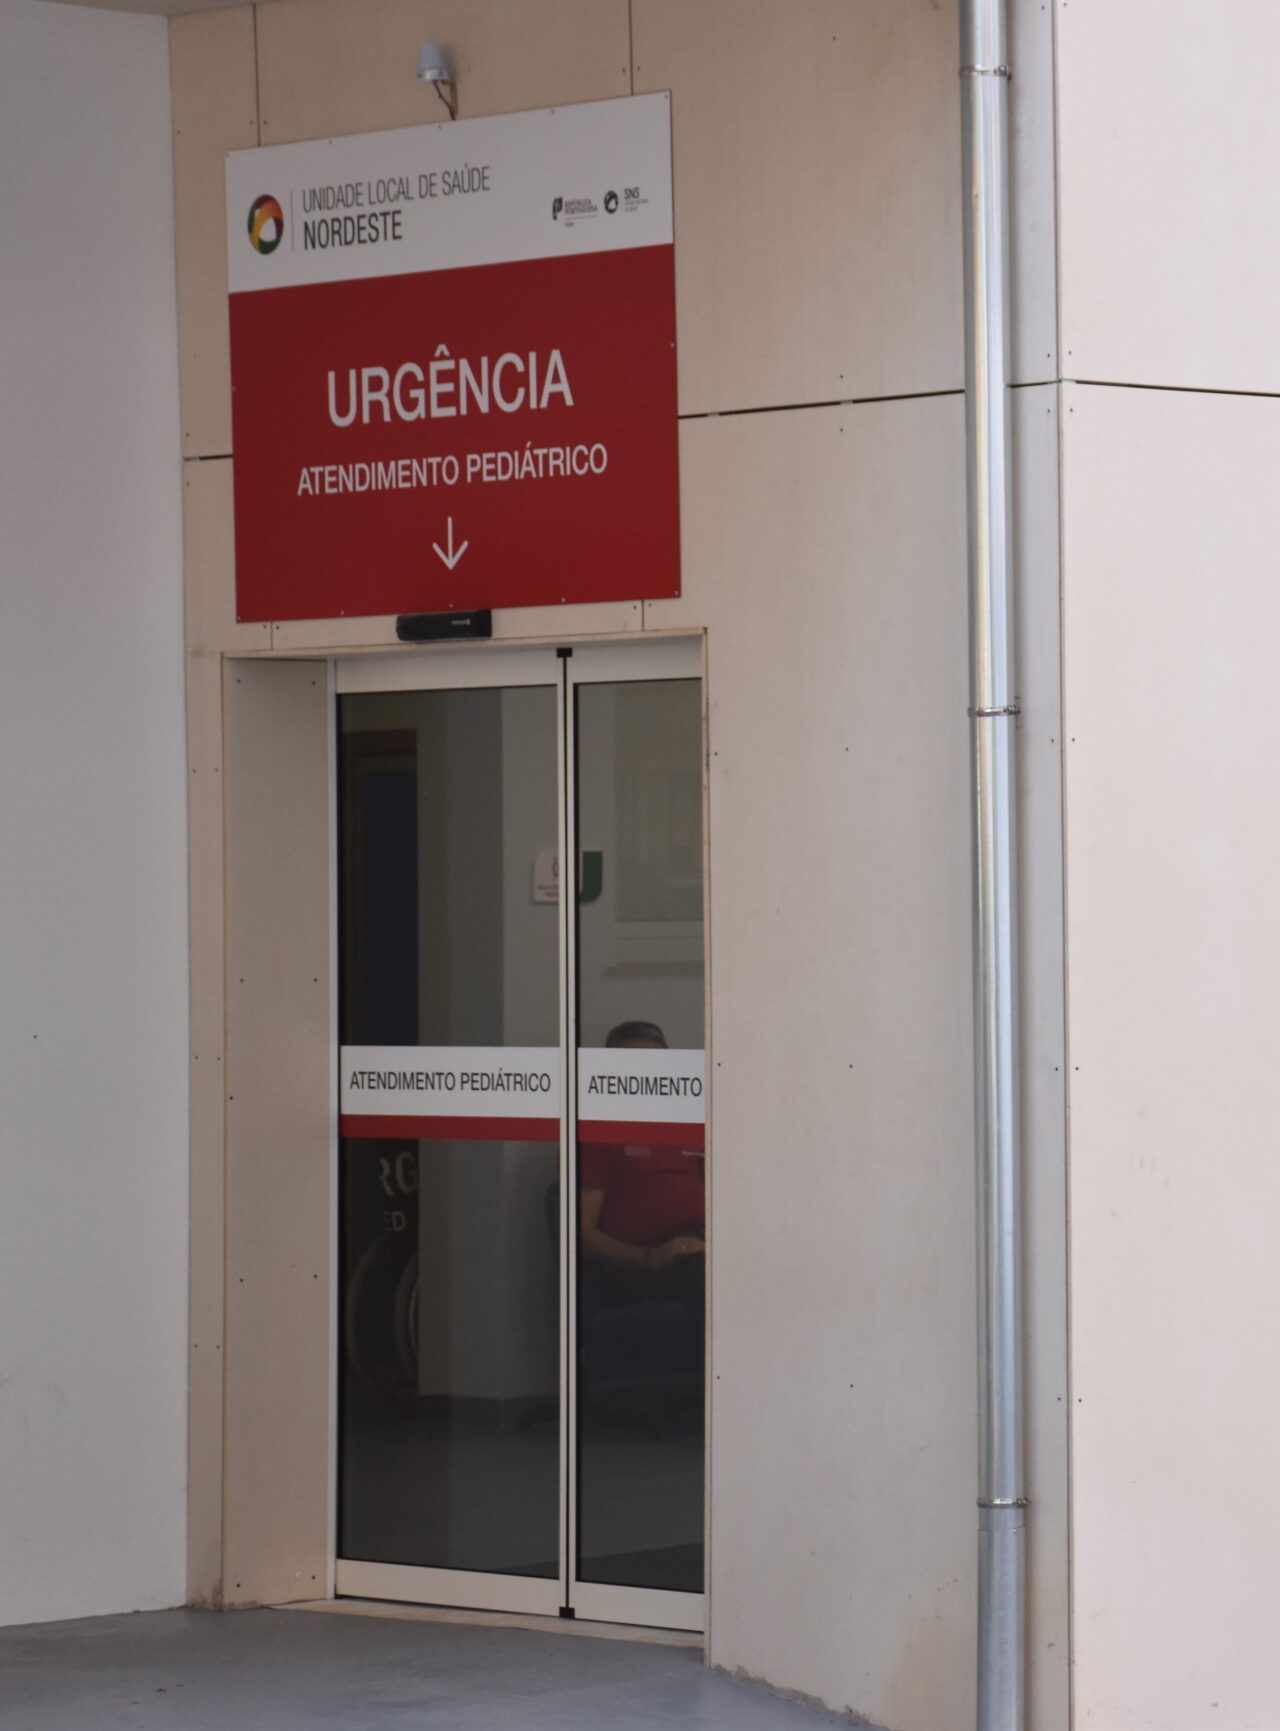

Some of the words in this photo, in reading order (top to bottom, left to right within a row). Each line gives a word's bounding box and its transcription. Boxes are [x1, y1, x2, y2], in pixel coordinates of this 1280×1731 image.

[303, 182, 363, 213] UNIDADE
[368, 176, 415, 205] LOCAL
[418, 173, 437, 199] DE
[442, 164, 491, 196] SAÚDE
[624, 186, 640, 200] SNS
[304, 210, 403, 250] NORDESTE
[327, 344, 574, 427] URGÊNCIA
[297, 455, 459, 496] ATENDIMENTO
[466, 441, 608, 484] PEDIÁTRICO
[350, 1071, 456, 1091] ATENDIMENTO
[460, 1067, 551, 1093] PEDIÁTRICO
[588, 1075, 703, 1097] ATENDIMENTO
